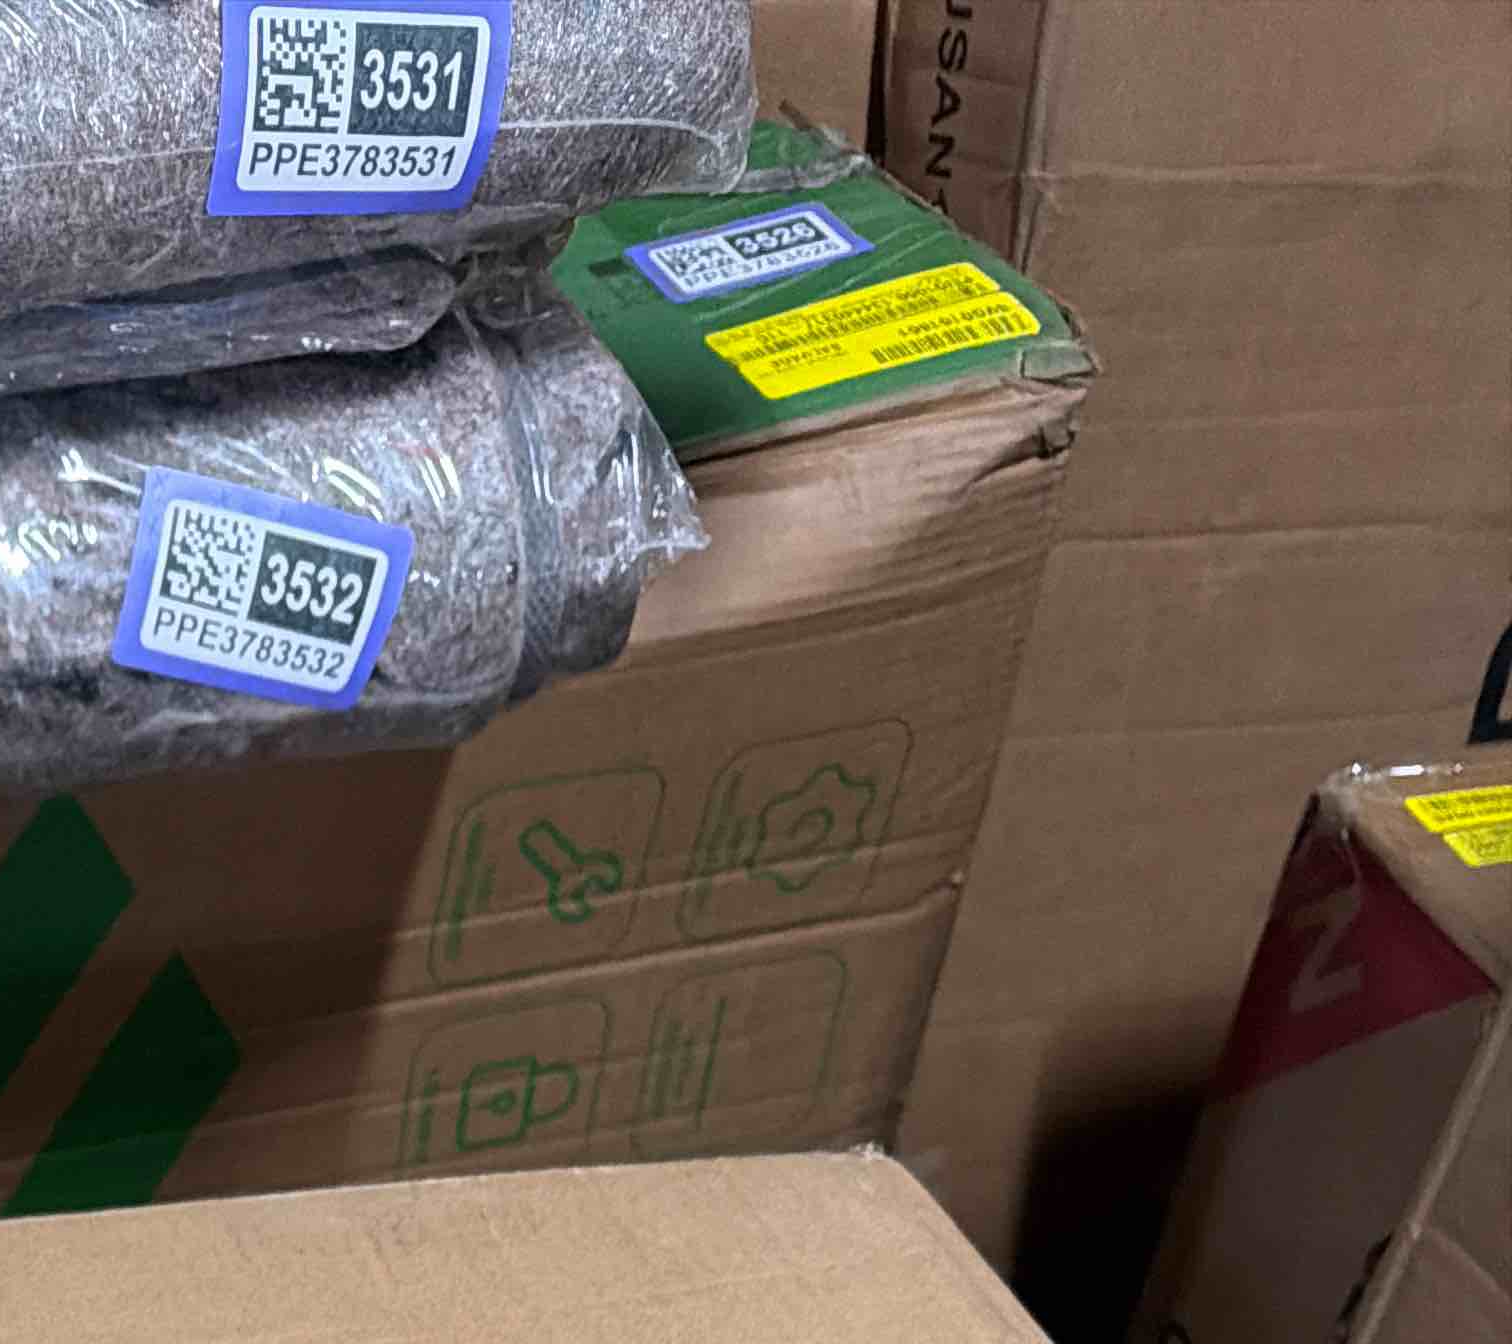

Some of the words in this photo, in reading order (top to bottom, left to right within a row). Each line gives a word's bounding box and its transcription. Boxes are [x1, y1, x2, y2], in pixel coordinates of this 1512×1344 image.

[360, 48, 464, 112] 3531
[248, 141, 457, 178] PPE3783531
[260, 552, 364, 626] 3532
[153, 606, 346, 680] PPE3783532
